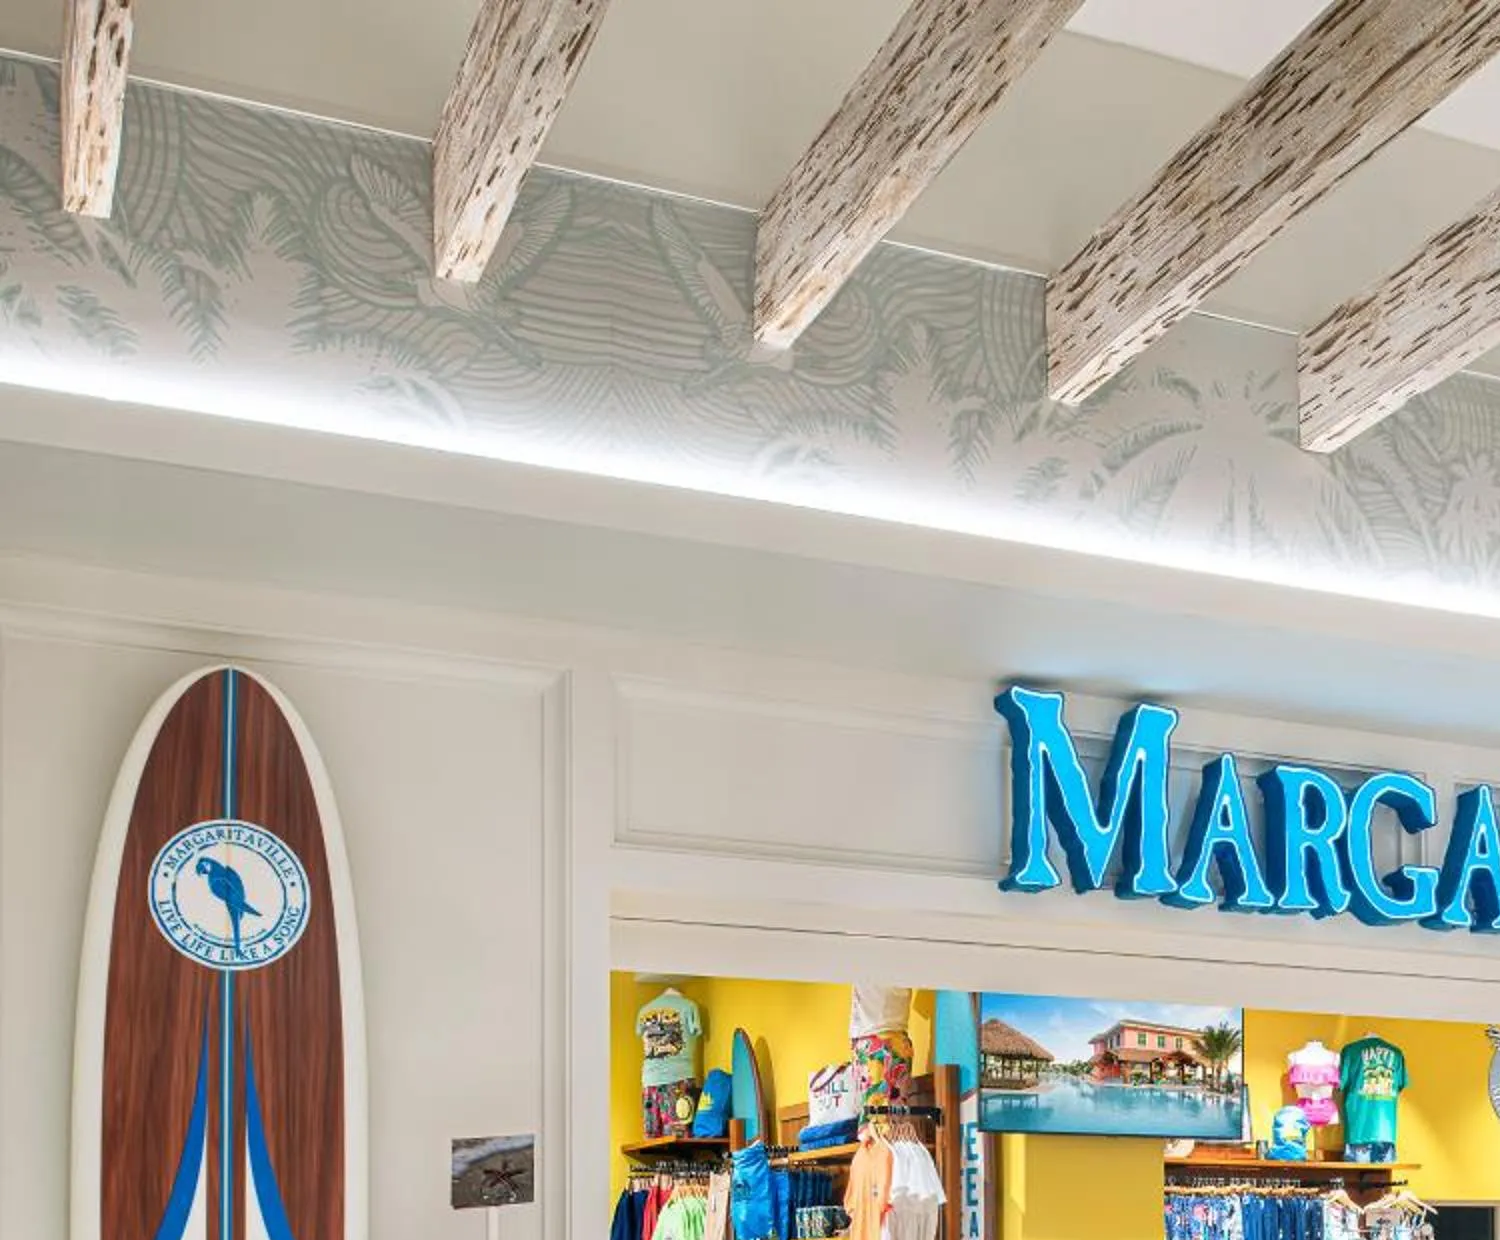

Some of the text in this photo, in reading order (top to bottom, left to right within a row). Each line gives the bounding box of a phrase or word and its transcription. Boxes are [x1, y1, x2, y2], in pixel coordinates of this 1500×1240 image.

[166, 829, 295, 879] MARGARITAVILLE
[158, 900, 183, 932] LIVE
[181, 933, 213, 958] LIFE
[262, 943, 273, 955] A
[273, 906, 301, 945] SONG
